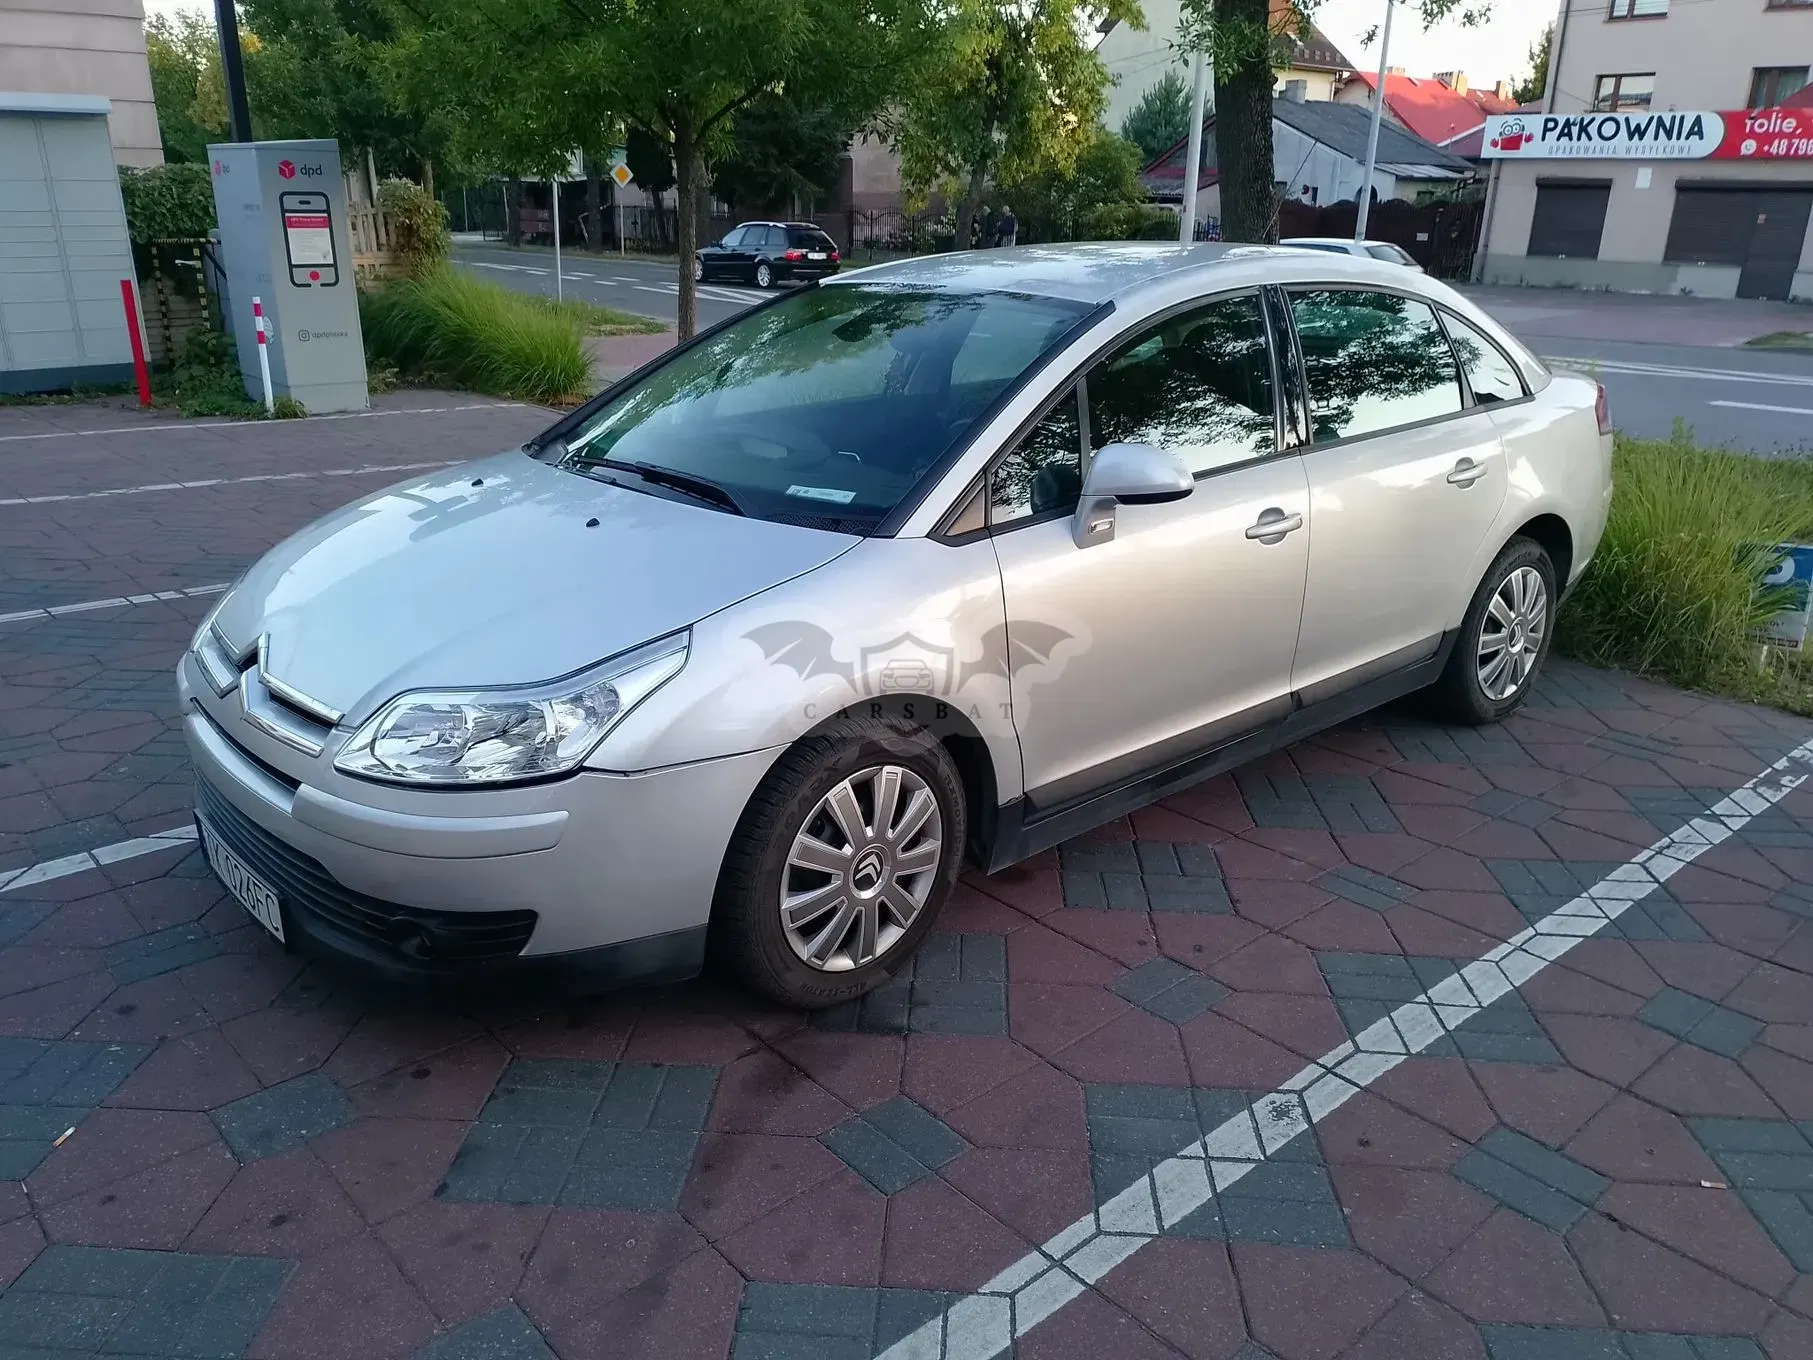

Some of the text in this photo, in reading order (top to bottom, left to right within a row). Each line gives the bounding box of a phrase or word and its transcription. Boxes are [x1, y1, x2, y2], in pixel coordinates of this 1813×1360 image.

[1541, 114, 1704, 142] PAKOWNIA
[1763, 138, 1788, 155] +48
[300, 164, 322, 178] dpd
